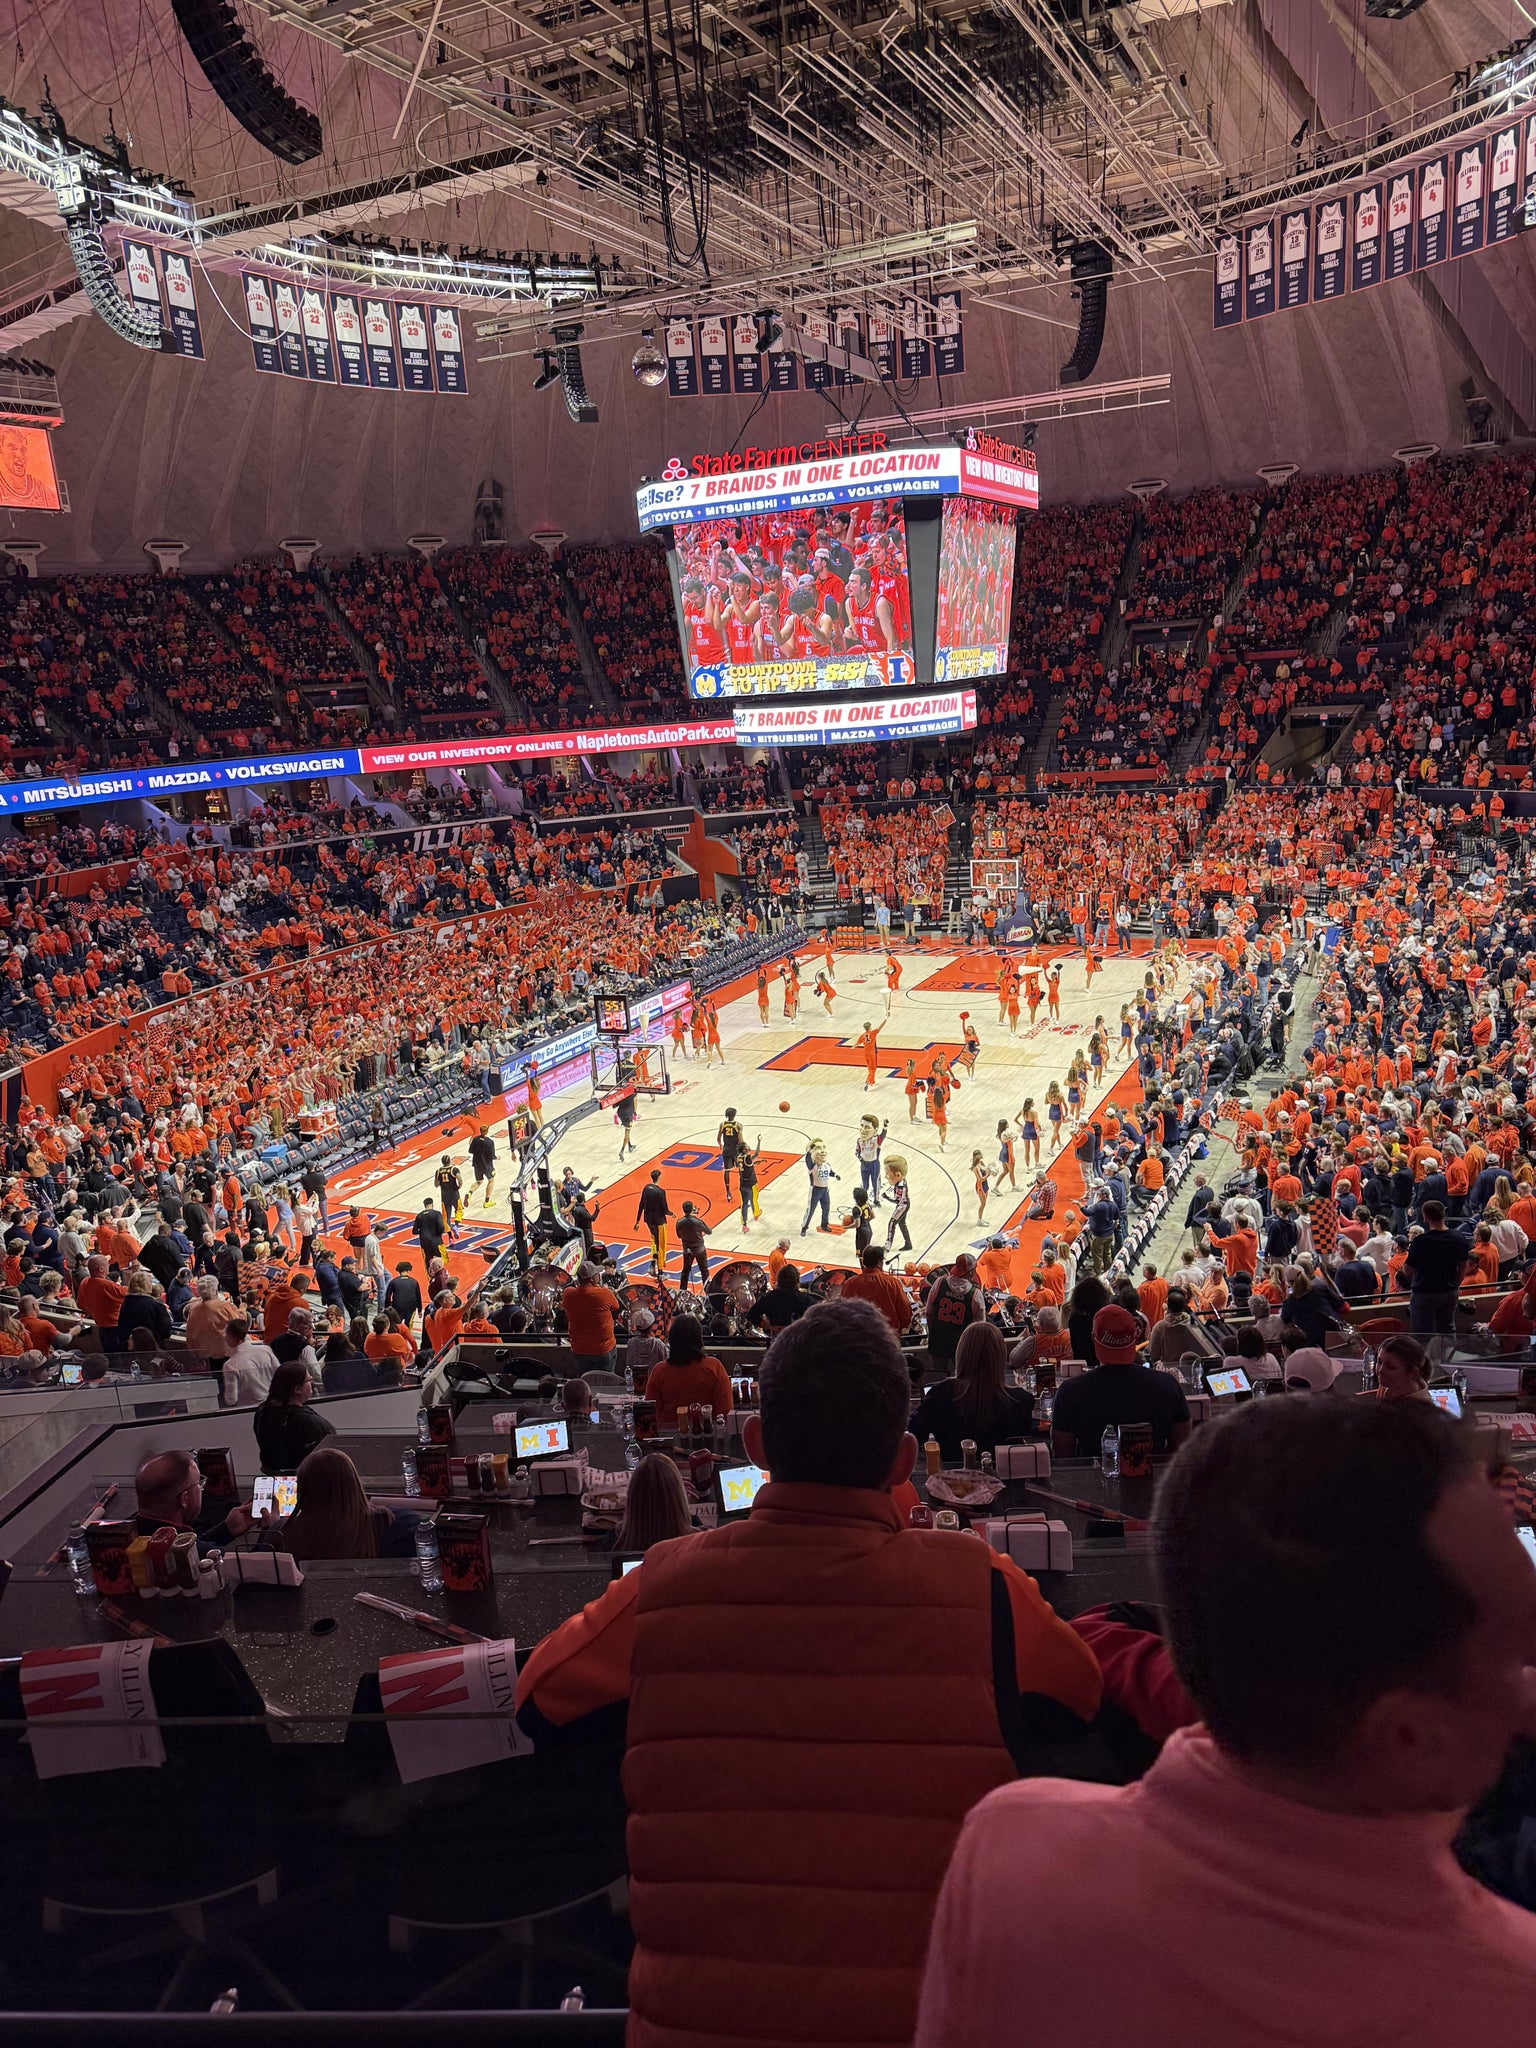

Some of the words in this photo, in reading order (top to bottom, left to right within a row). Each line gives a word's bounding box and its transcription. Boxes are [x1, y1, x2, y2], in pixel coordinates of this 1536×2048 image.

[1465, 175, 1473, 189] 5
[1428, 189, 1437, 201] 4
[1393, 201, 1407, 217] 34
[1361, 214, 1374, 229] 30
[1326, 225, 1335, 234] 25
[1255, 248, 1264, 256] 25
[137, 272, 149, 283] 40
[174, 281, 186, 293] 33
[255, 301, 264, 312] 11
[282, 308, 292, 318] 37
[309, 314, 320, 325] 22
[341, 319, 353, 329] 35
[372, 323, 384, 333] 30
[407, 327, 419, 337] 23
[441, 330, 453, 339] 40
[674, 337, 685, 346] 35
[709, 336, 718, 344] 12
[740, 335, 751, 344] 15
[798, 432, 887, 462] CENTER
[690, 484, 701, 499] 7
[705, 473, 777, 498] BRANDS
[782, 469, 801, 487] IN
[807, 464, 844, 484] ONE
[850, 453, 941, 478] LOCATION
[705, 498, 778, 517] MITSUBISHI
[790, 491, 836, 506] MAZDA
[848, 480, 940, 498] VOLKSWAGEN
[729, 661, 817, 678] COUNTDOWN
[825, 662, 868, 682] 5:51
[732, 678, 755, 694] TO
[757, 674, 817, 693] TIP-OFF
[749, 713, 755, 727] 7
[758, 710, 818, 727] BRANDS
[823, 708, 843, 723] IN
[848, 705, 885, 722] ONE
[890, 697, 959, 718] LOCATION
[757, 732, 818, 744] MITSUBISHI
[831, 728, 876, 741] MAZDA
[888, 720, 959, 737] VOLKSWAGEN
[372, 753, 405, 765] VIEW
[408, 750, 437, 762] OUR
[440, 745, 513, 759] INVENTORY
[515, 741, 564, 753] ONLINE
[23, 778, 133, 804] MITSUBISHI
[148, 770, 212, 789] MAZDA
[225, 757, 346, 780] VOLKSWAGEN
[1007, 928, 1032, 943] LIBMAN
[605, 1001, 625, 1011] 5:51
[546, 1047, 554, 1056] Go
[554, 1033, 582, 1052] Anywhere
[582, 1025, 597, 1040] Else?
[725, 1127, 734, 1136] 21
[441, 1173, 449, 1183] 11
[937, 1297, 966, 1326] 23
[1212, 1379, 1228, 1393] M
[1230, 1375, 1243, 1389] I
[521, 1434, 539, 1449] M
[546, 1429, 560, 1447] I
[727, 1478, 753, 1501] M
[488, 1652, 515, 1712] ILLIN
[122, 1667, 145, 1719] ILLIN
